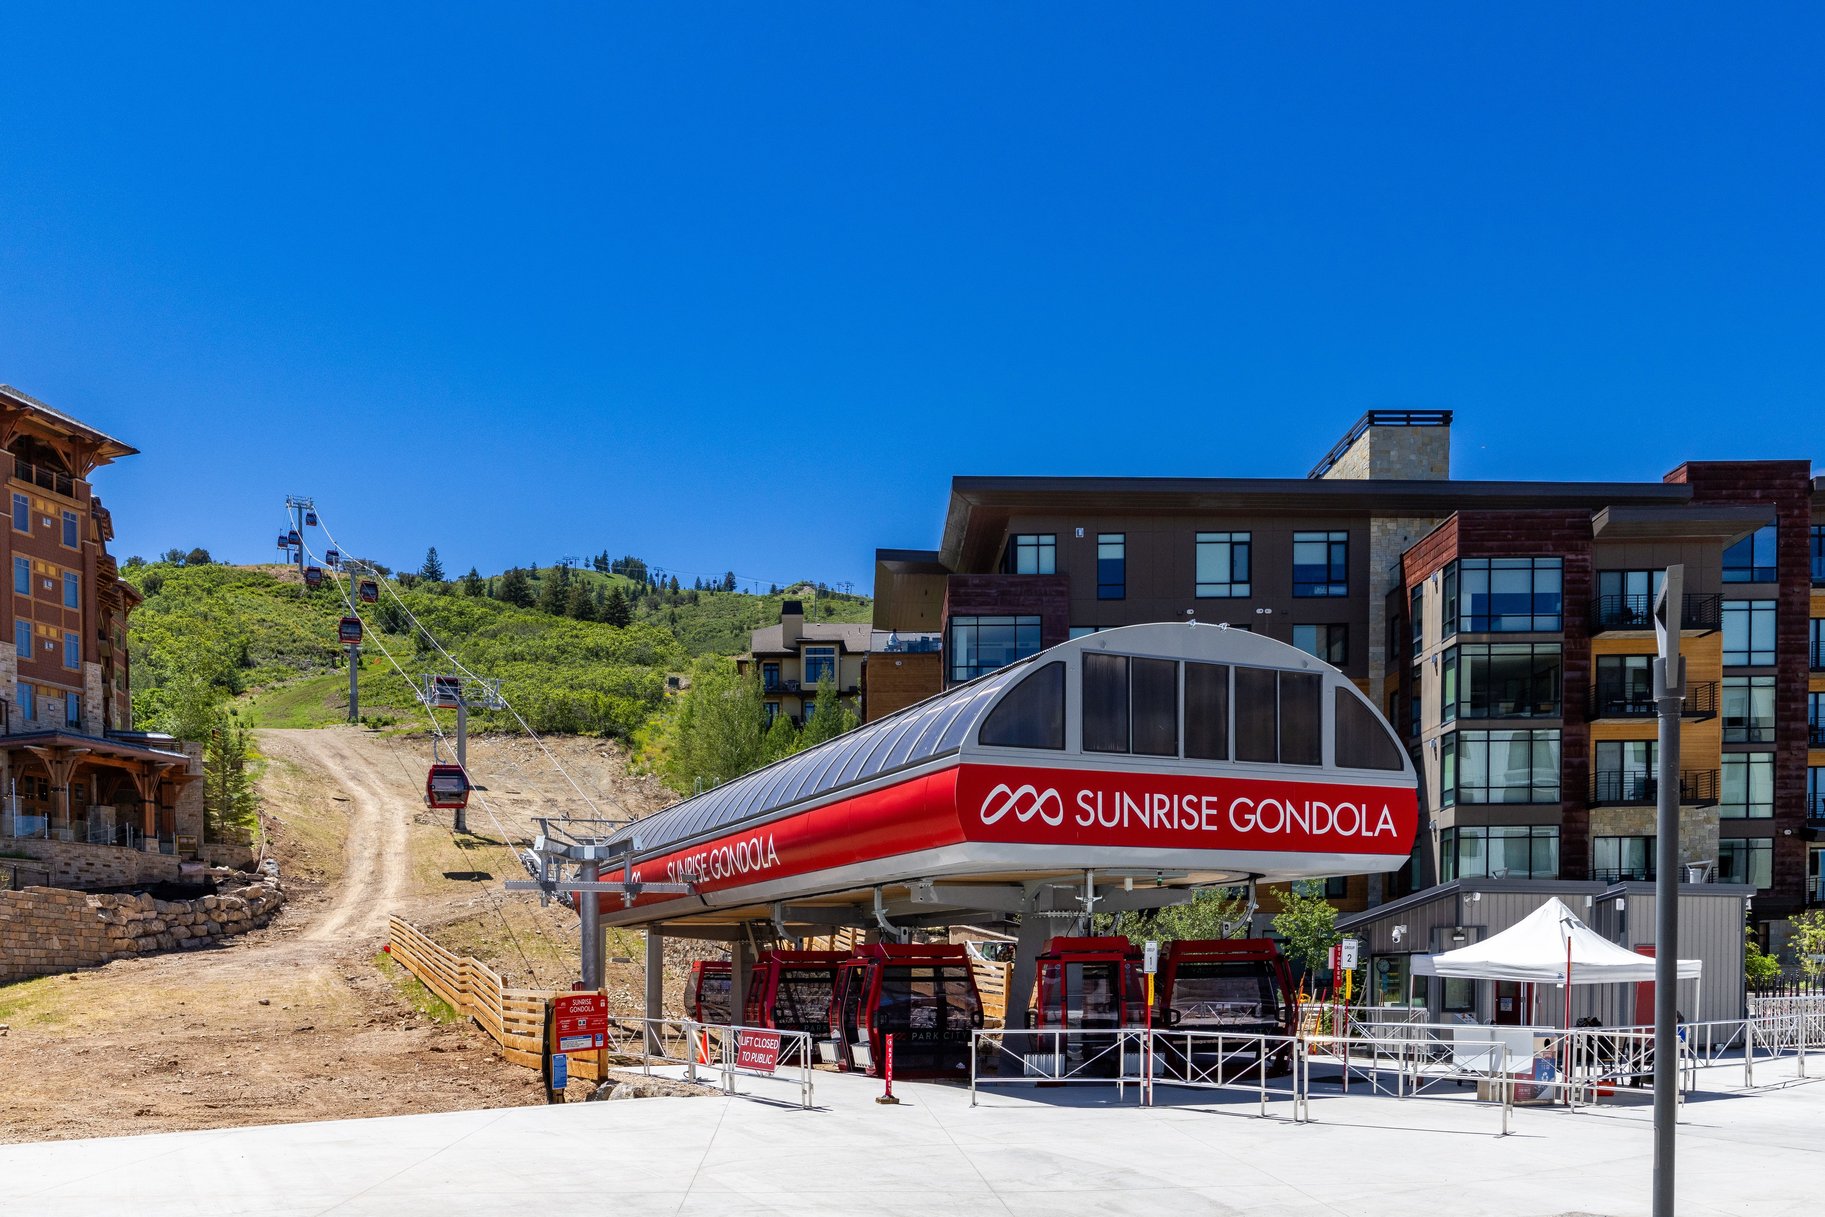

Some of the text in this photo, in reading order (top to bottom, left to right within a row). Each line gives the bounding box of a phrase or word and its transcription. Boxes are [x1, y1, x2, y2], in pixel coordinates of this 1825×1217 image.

[1075, 789, 1398, 838] SUNRISE GONDOLA
[667, 833, 780, 883] SUNRISE GONDOLA
[1347, 953, 1352, 963] 2
[572, 998, 592, 1006] SUNRISE
[569, 1006, 595, 1014] GONDOLA
[911, 1031, 968, 1041] PARK CITY
[741, 1036, 779, 1050] LIFT CLOSED
[742, 1051, 774, 1065] TO PUBLIC
